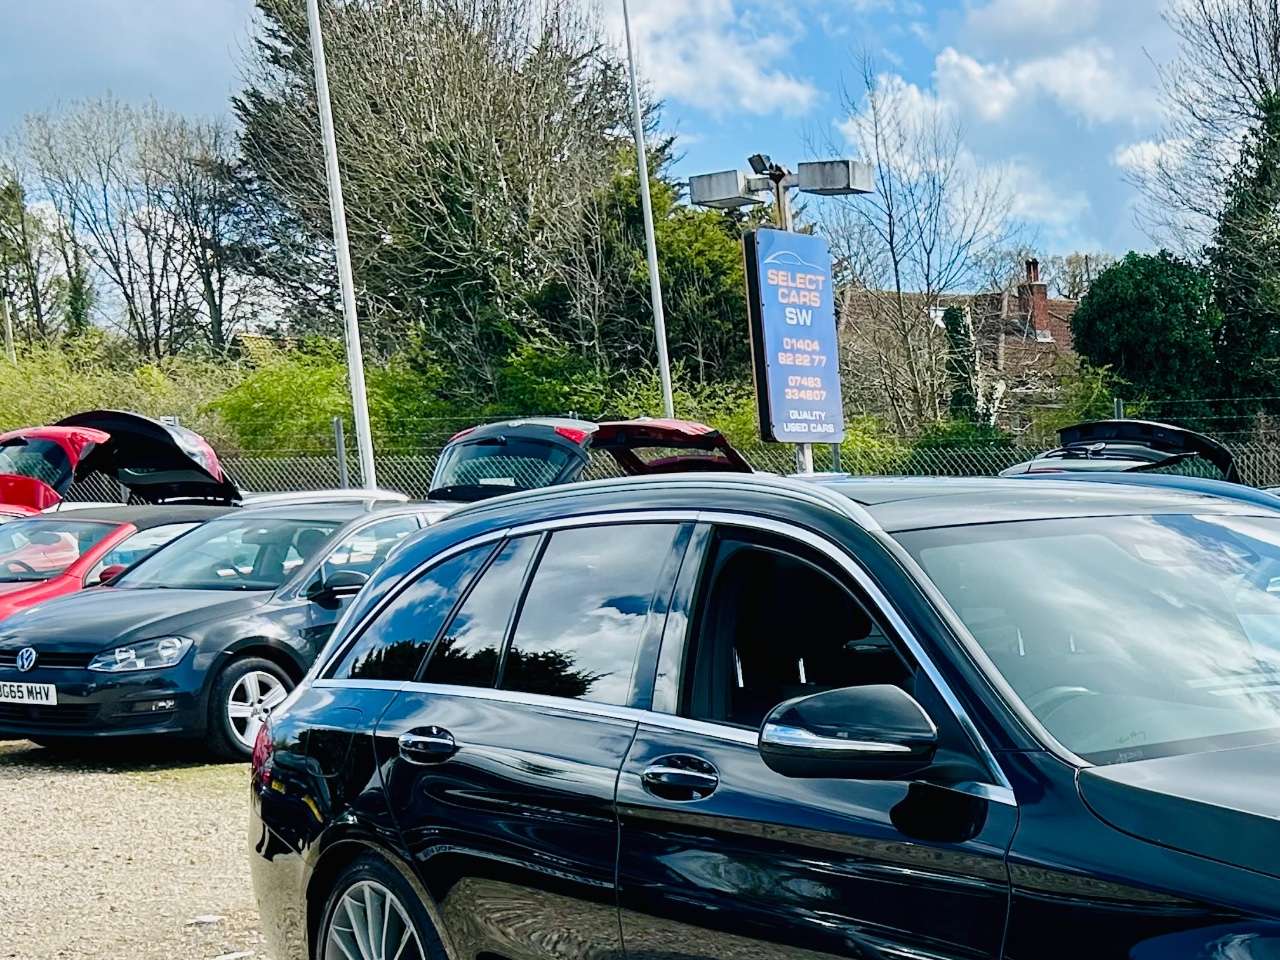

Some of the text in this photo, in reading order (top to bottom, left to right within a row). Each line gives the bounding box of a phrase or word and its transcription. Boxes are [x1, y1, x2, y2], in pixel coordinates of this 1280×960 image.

[767, 269, 825, 290] SELECT
[778, 287, 821, 307] CARS
[785, 307, 812, 326] SW
[783, 337, 820, 352] 01404
[789, 410, 826, 421] QUALITY
[783, 422, 835, 433] USED CARS
[26, 685, 50, 701] MHV
